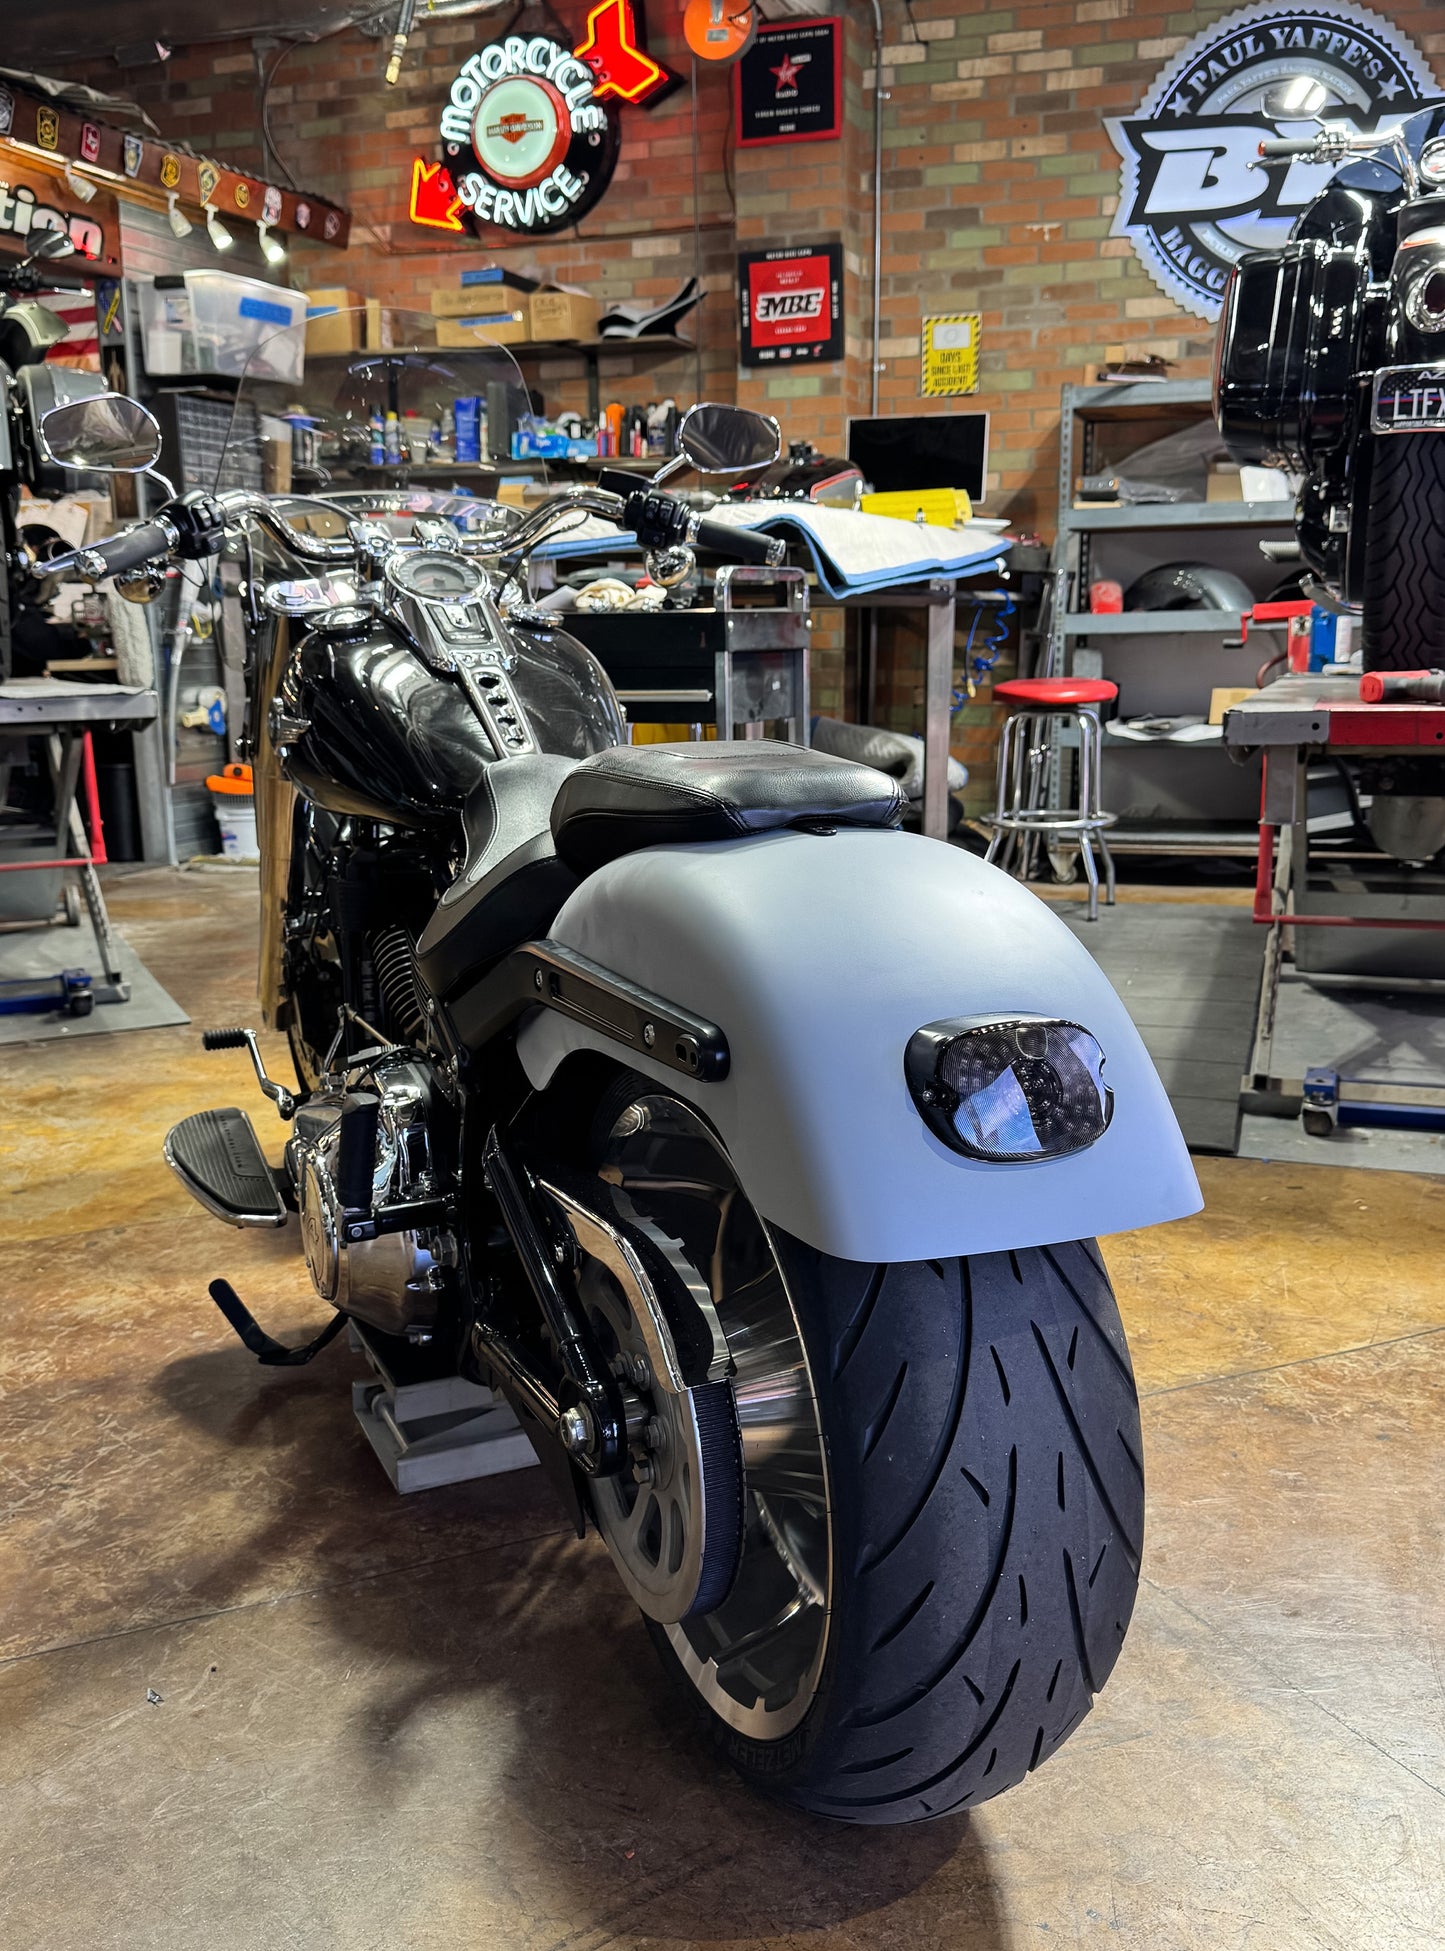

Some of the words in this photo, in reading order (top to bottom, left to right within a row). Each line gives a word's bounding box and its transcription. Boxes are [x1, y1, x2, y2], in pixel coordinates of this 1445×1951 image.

[439, 35, 600, 142] MOTORCYCLE
[1186, 34, 1265, 96] PAUL
[1269, 26, 1387, 81] YAFFE'S
[457, 163, 581, 227] SERVICE
[757, 290, 823, 320] MBE
